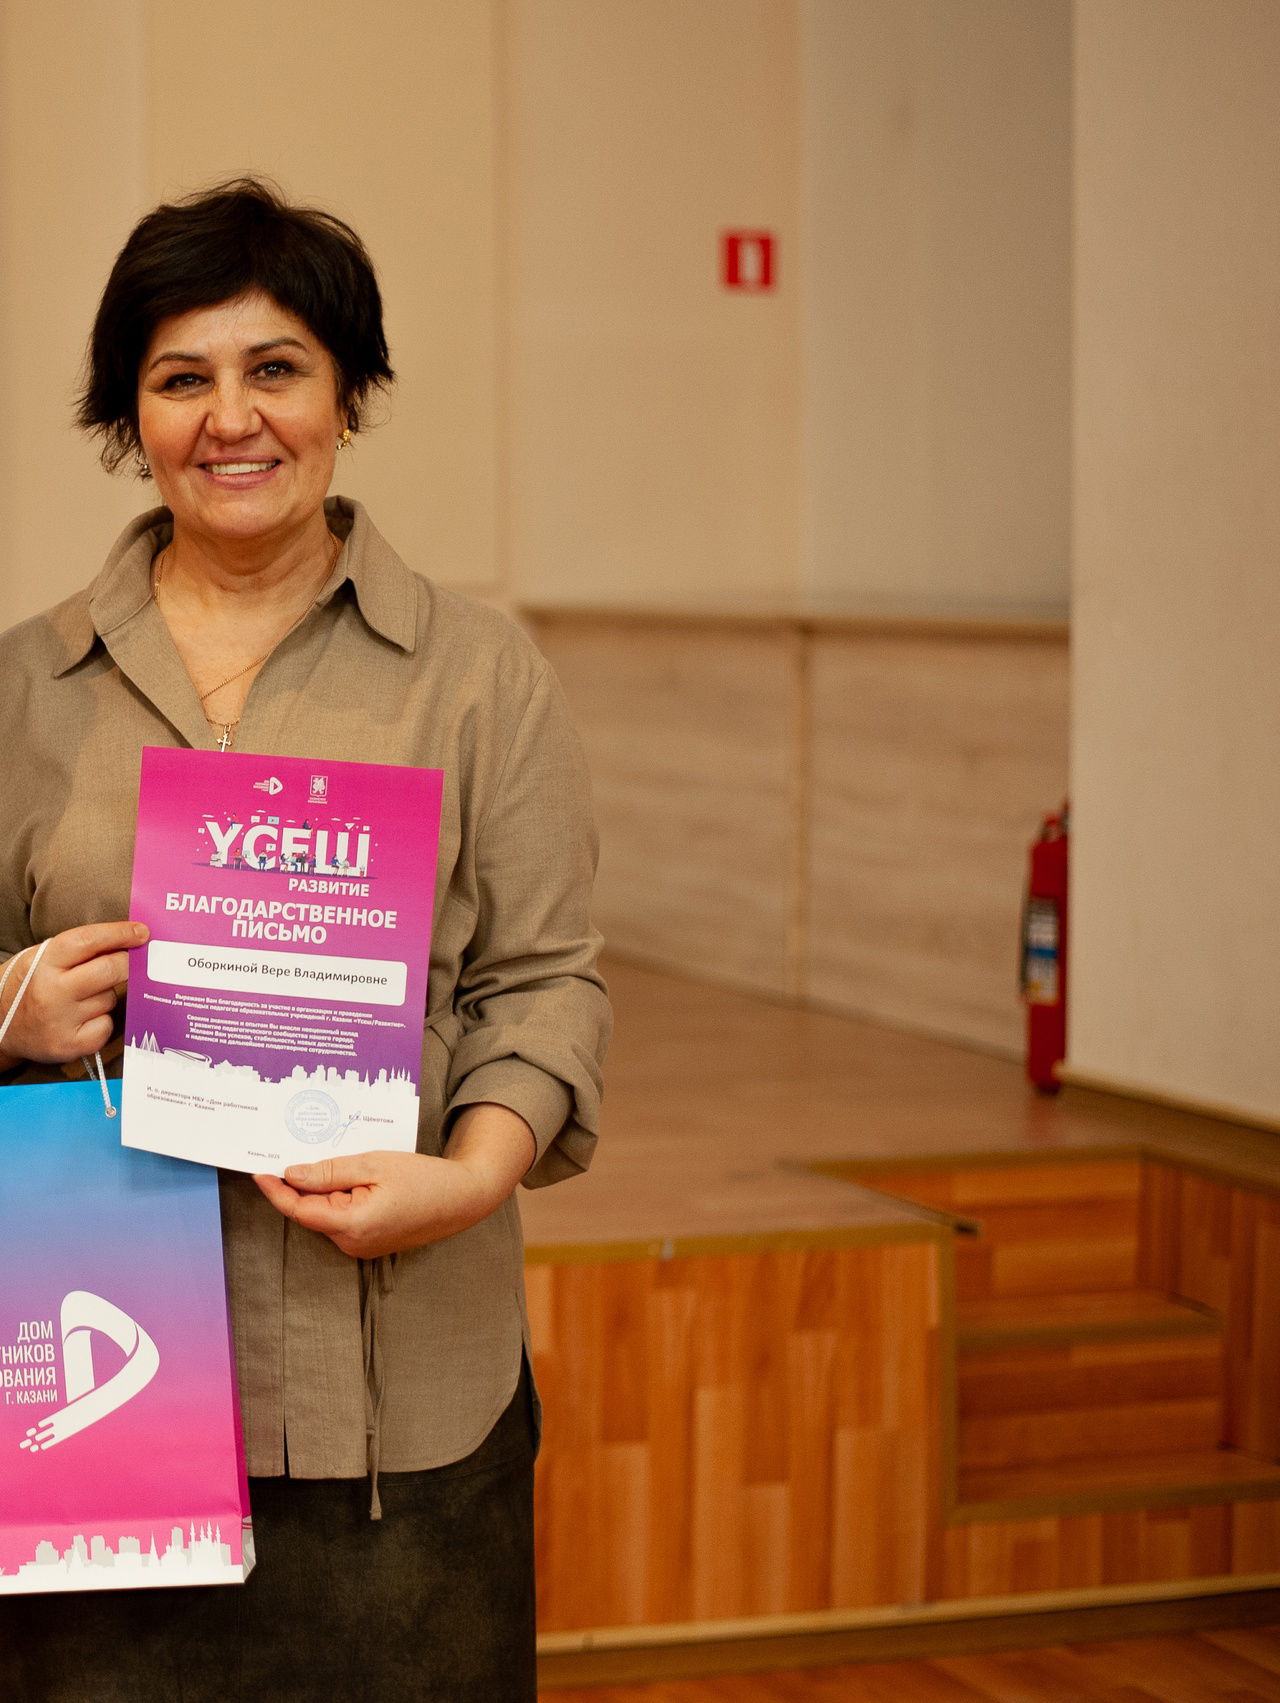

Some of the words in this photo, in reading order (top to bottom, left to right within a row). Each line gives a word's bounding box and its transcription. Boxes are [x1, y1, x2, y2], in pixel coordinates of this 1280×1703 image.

[288, 878, 370, 897] РАЗВИТИЕ
[165, 892, 398, 929] БЛАГОДАРСТВЕННОЕ
[231, 919, 327, 944] ПИСЬМО
[187, 957, 258, 974] Оборкиной
[261, 964, 291, 978] Вере
[294, 967, 388, 985] Владимировне
[175, 993, 206, 1003] Выражаем
[218, 998, 260, 1008] благодарность
[296, 1007, 333, 1015] организации
[338, 1011, 373, 1019] проведении
[186, 1014, 209, 1022] Своими
[245, 1021, 269, 1029] опытом
[301, 1027, 340, 1035] неоценимый
[194, 1022, 222, 1030] развитие
[222, 1026, 272, 1035] педагогического
[273, 1030, 308, 1039] сообщества
[189, 1027, 214, 1036] Желаем
[317, 1041, 354, 1050] достижений
[190, 1034, 219, 1043] надеемся
[227, 1039, 265, 1048] дальнейшее
[265, 1043, 308, 1052] плодотворное
[161, 1089, 191, 1100] директора
[223, 1101, 258, 1111] работников
[194, 1102, 215, 1111] Казани
[17, 1320, 54, 1344] ДОМ
[5, 1391, 15, 1405] Г.
[16, 1389, 58, 1405] КАЗАНИ
